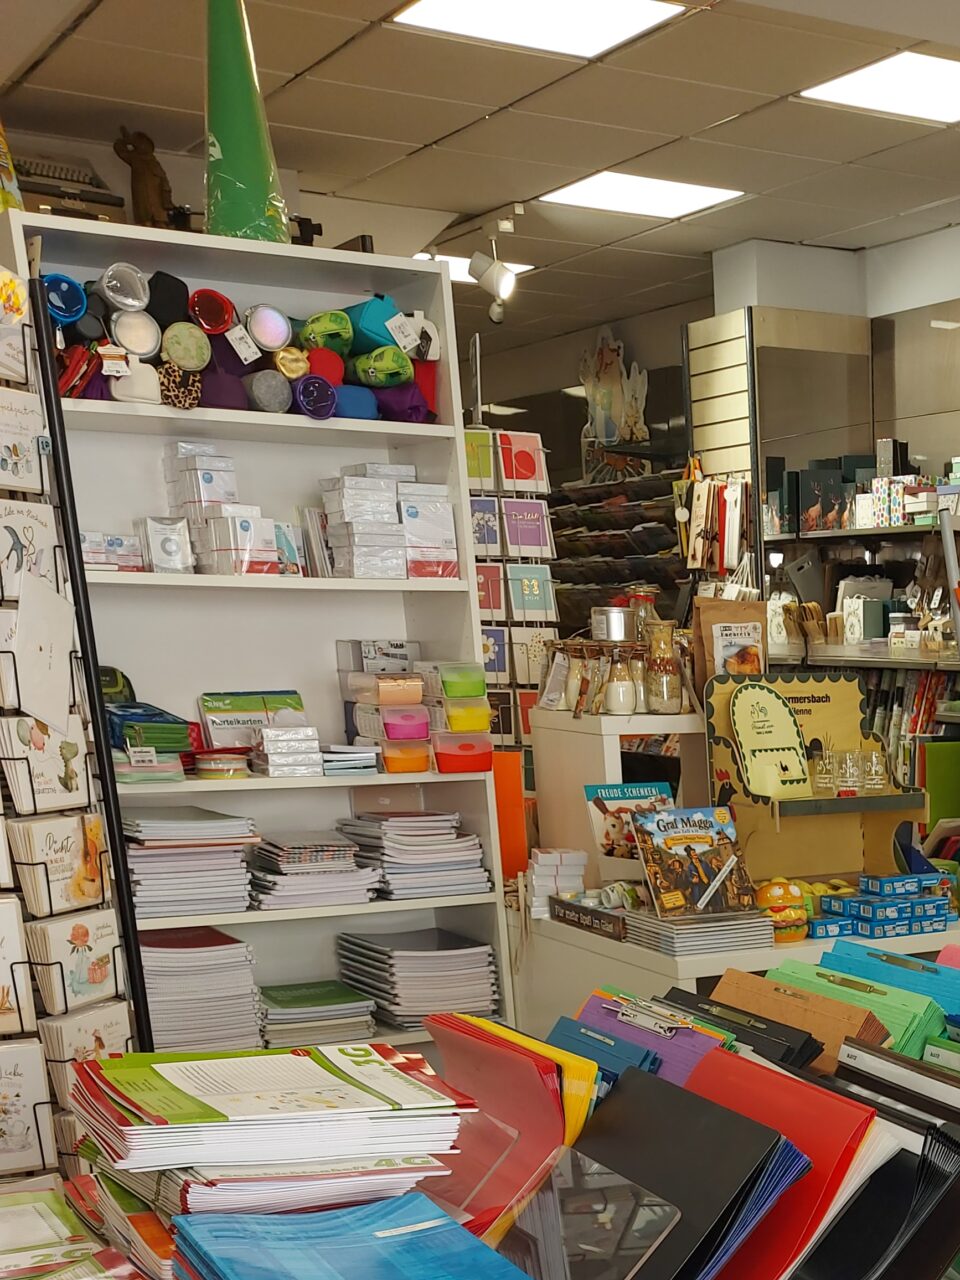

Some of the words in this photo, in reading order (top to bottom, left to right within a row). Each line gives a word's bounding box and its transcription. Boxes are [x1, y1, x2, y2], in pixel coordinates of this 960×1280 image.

[784, 693, 831, 705] rmersbach
[597, 789, 622, 798] FREUDE
[624, 786, 659, 797] SCHENKEN!
[656, 818, 679, 833] Graf
[681, 817, 714, 831] Magga
